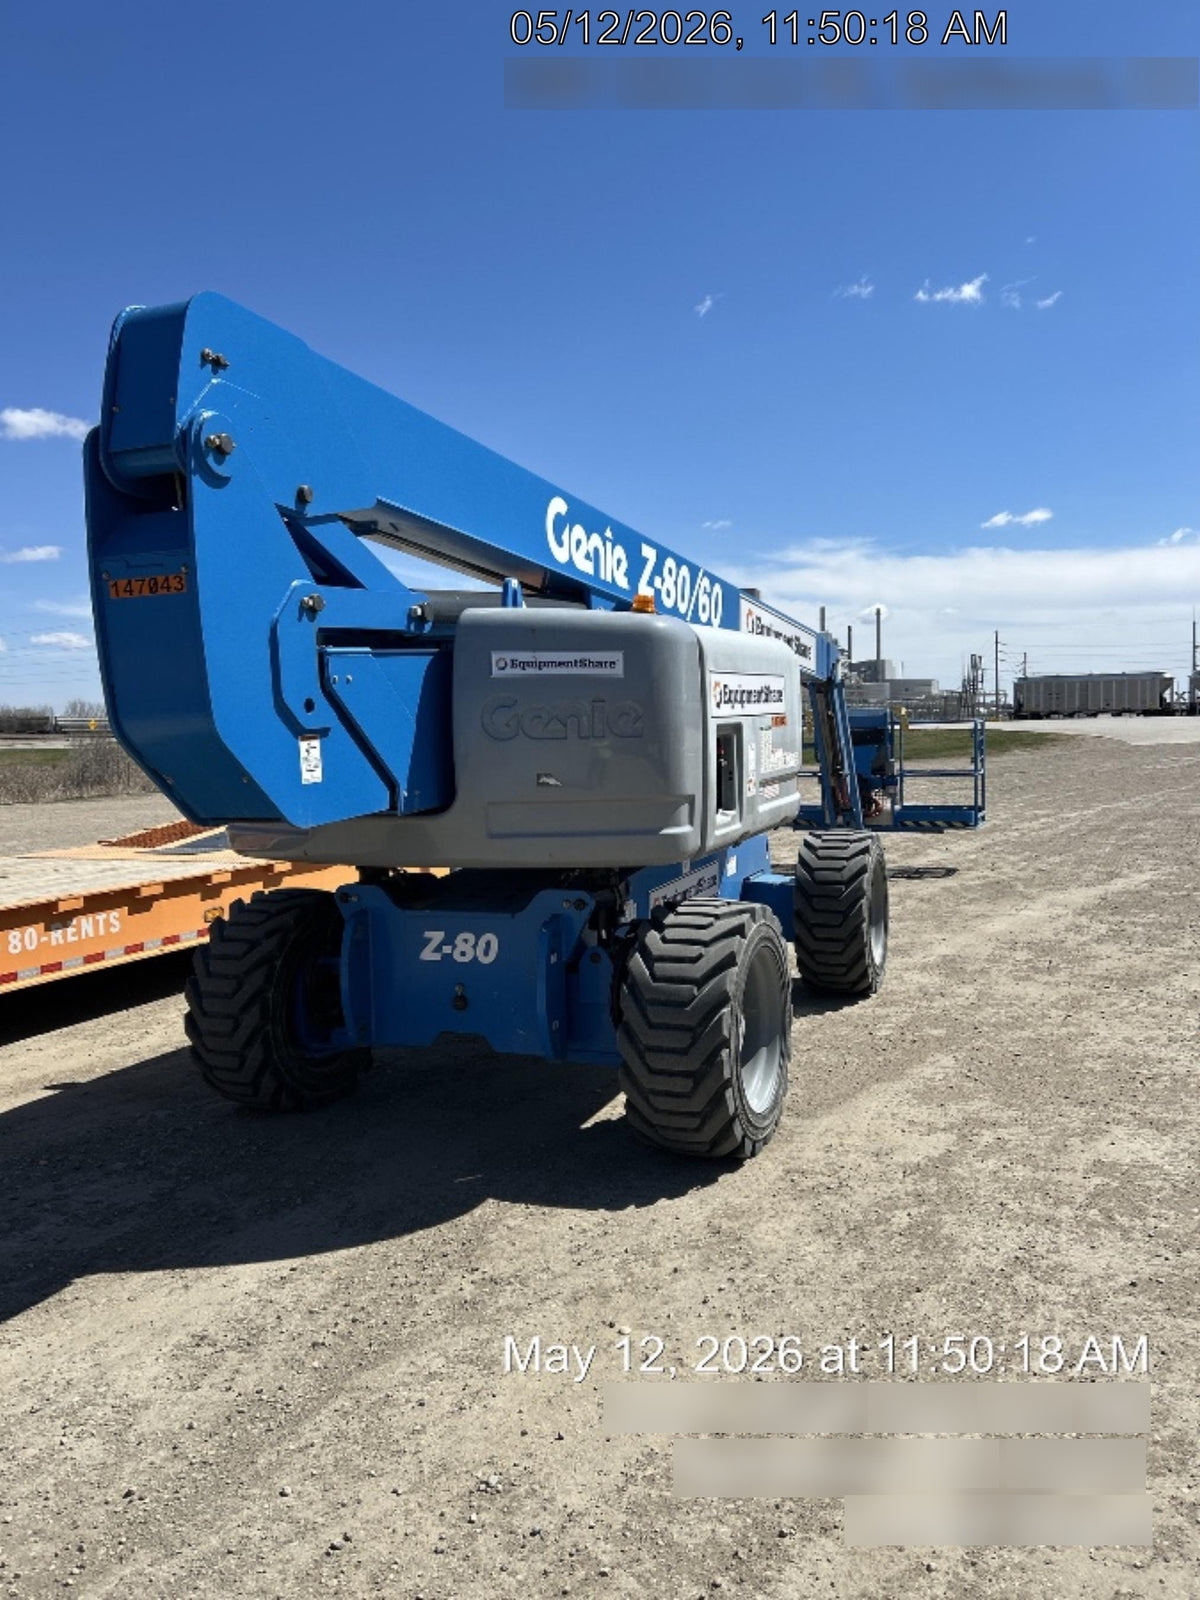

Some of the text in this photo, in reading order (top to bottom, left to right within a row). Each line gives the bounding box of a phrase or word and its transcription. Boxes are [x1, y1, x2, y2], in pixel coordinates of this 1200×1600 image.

[546, 496, 722, 628] Genie Z-80/60
[111, 575, 185, 597] 147043
[510, 658, 617, 671] EquipmentShare
[480, 694, 644, 742] Genie
[7, 911, 121, 954] 80-RENTS
[419, 931, 499, 964] Z-80
